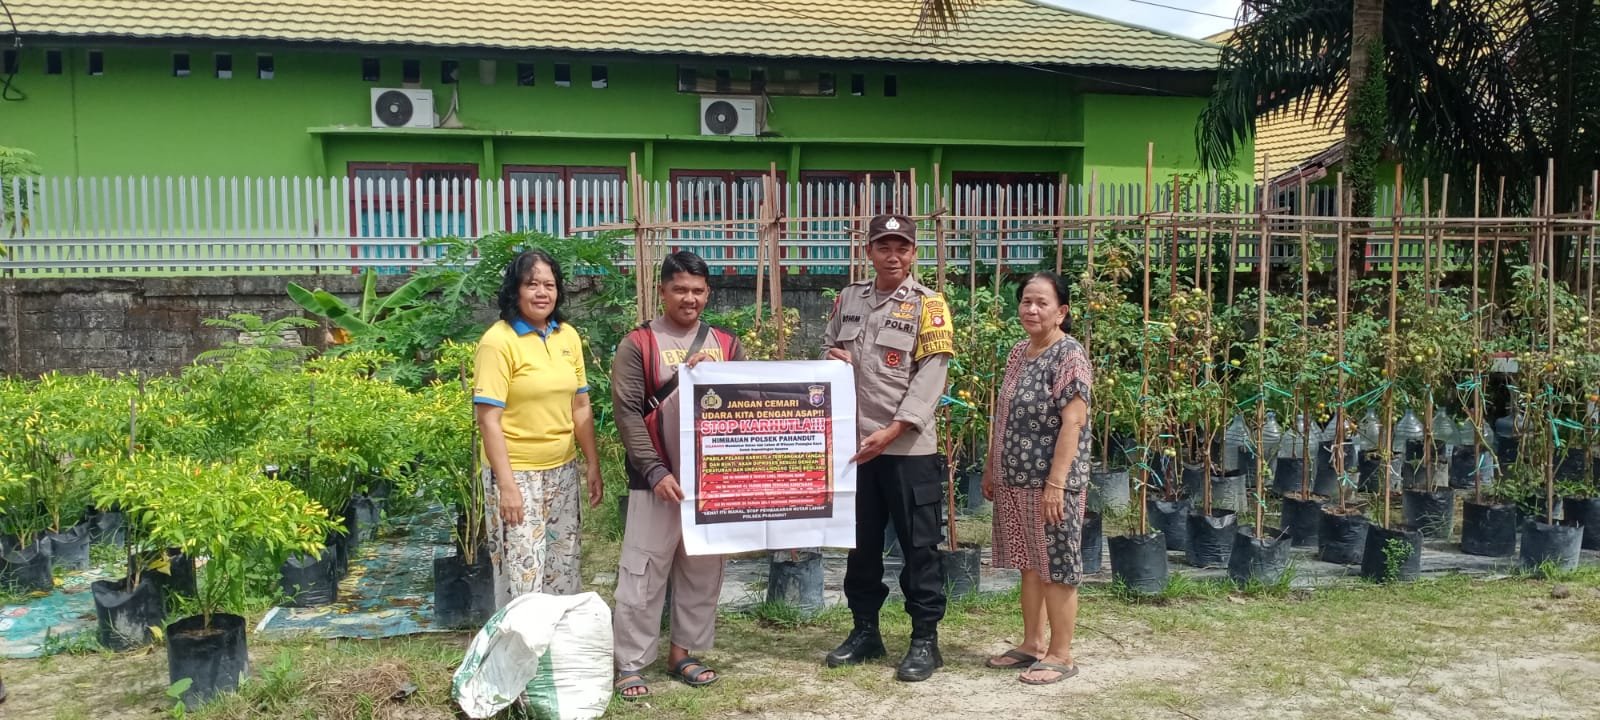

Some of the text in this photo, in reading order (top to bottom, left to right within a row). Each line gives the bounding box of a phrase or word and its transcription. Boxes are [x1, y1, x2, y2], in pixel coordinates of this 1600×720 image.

[884, 320, 914, 332] POLRI
[727, 400, 799, 408] JANGAN CEMARI
[756, 410, 793, 418] DENGAN
[796, 409, 824, 417] ASAP!!
[700, 417, 826, 434] STOP KARHUTLA!!!
